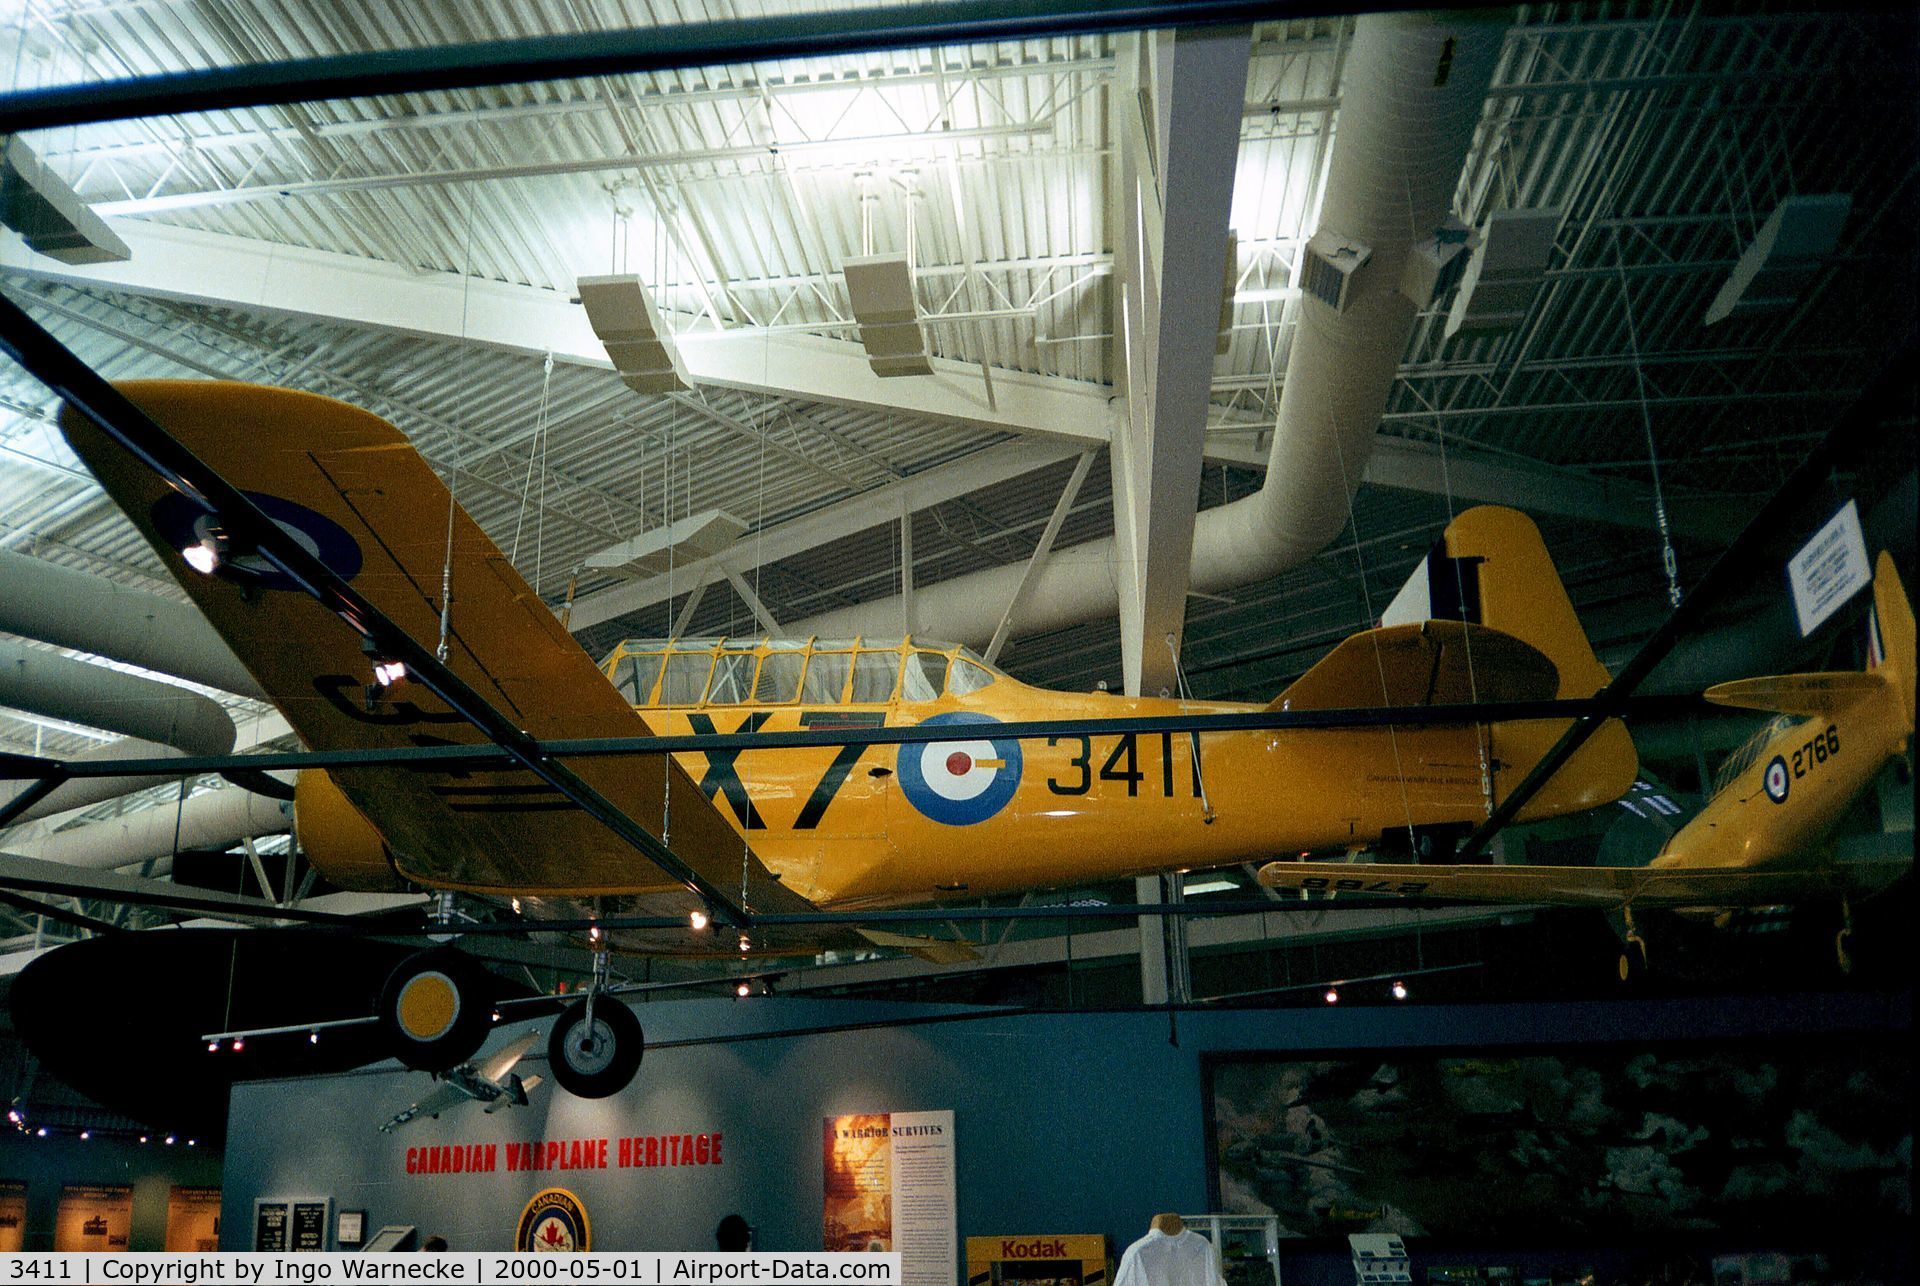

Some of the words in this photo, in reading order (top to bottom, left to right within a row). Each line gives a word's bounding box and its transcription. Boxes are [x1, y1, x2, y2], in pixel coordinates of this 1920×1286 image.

[1047, 733, 1202, 798] 3411
[1791, 724, 1840, 779] 2766
[843, 1125, 888, 1139] WARRIOR
[891, 1124, 943, 1137] SURVIVES
[405, 1143, 497, 1175] CANADIAN
[505, 1138, 608, 1172] WARPLANE
[618, 1132, 724, 1168] HERITAGE
[530, 1193, 575, 1214] CANADIAN
[1001, 1239, 1068, 1259] Kodak
